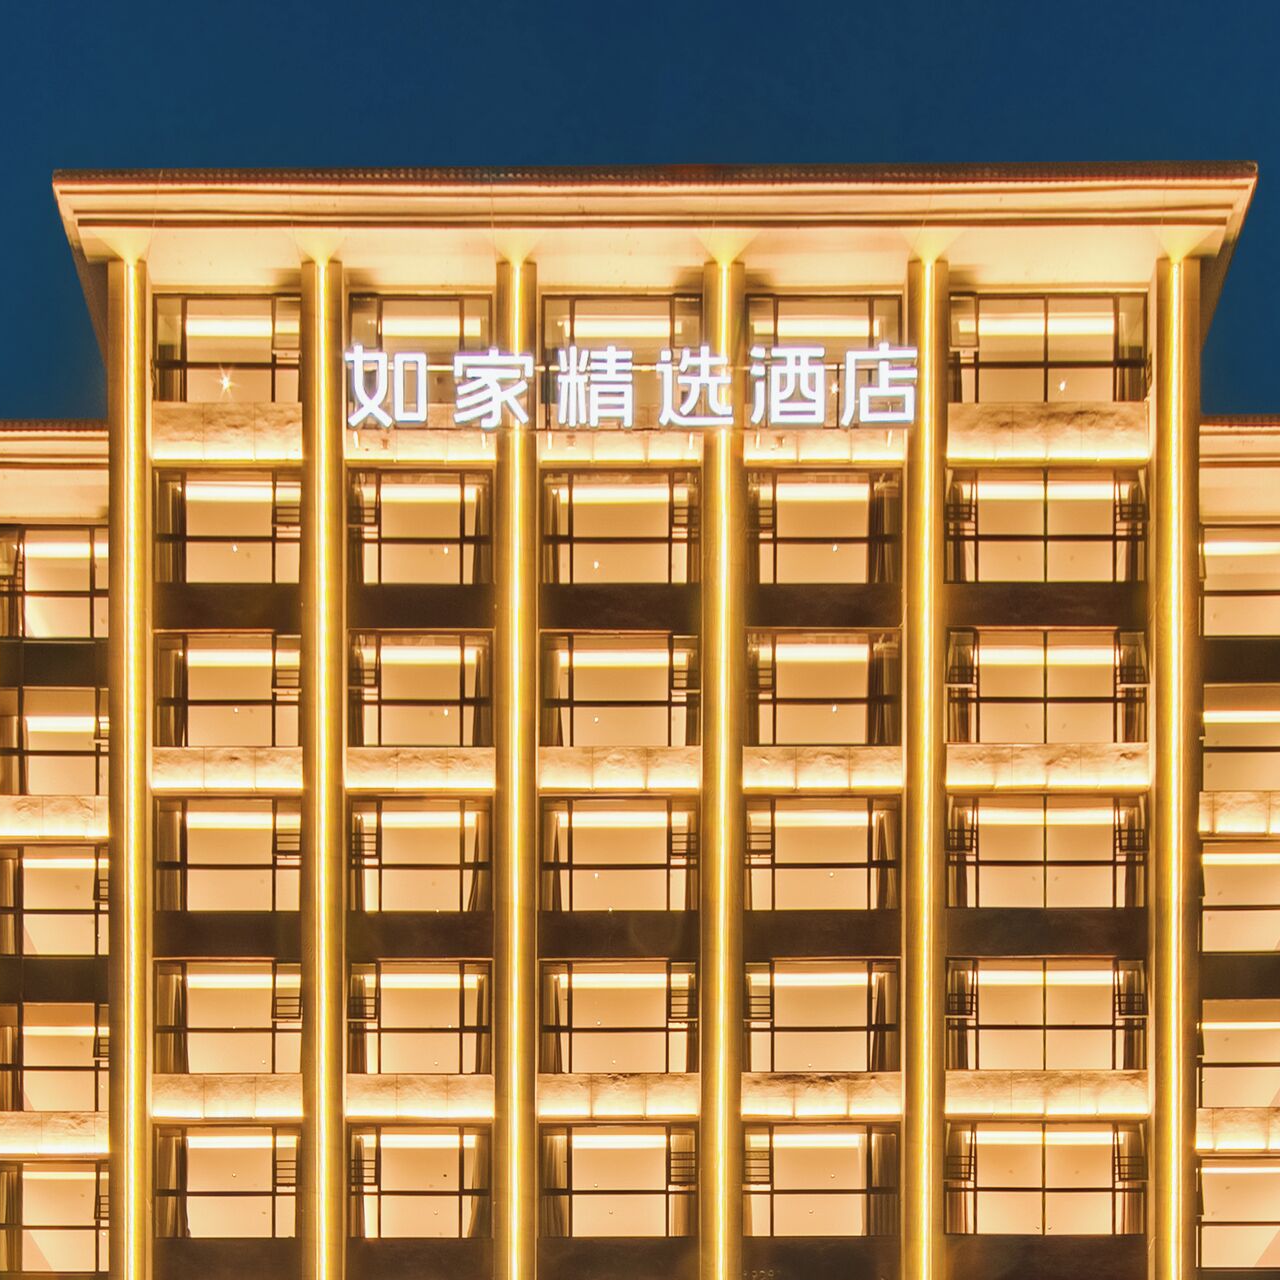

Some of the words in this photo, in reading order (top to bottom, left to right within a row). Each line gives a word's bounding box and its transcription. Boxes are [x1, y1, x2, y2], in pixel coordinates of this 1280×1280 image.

[344, 342, 919, 430] 如家精选酒店
